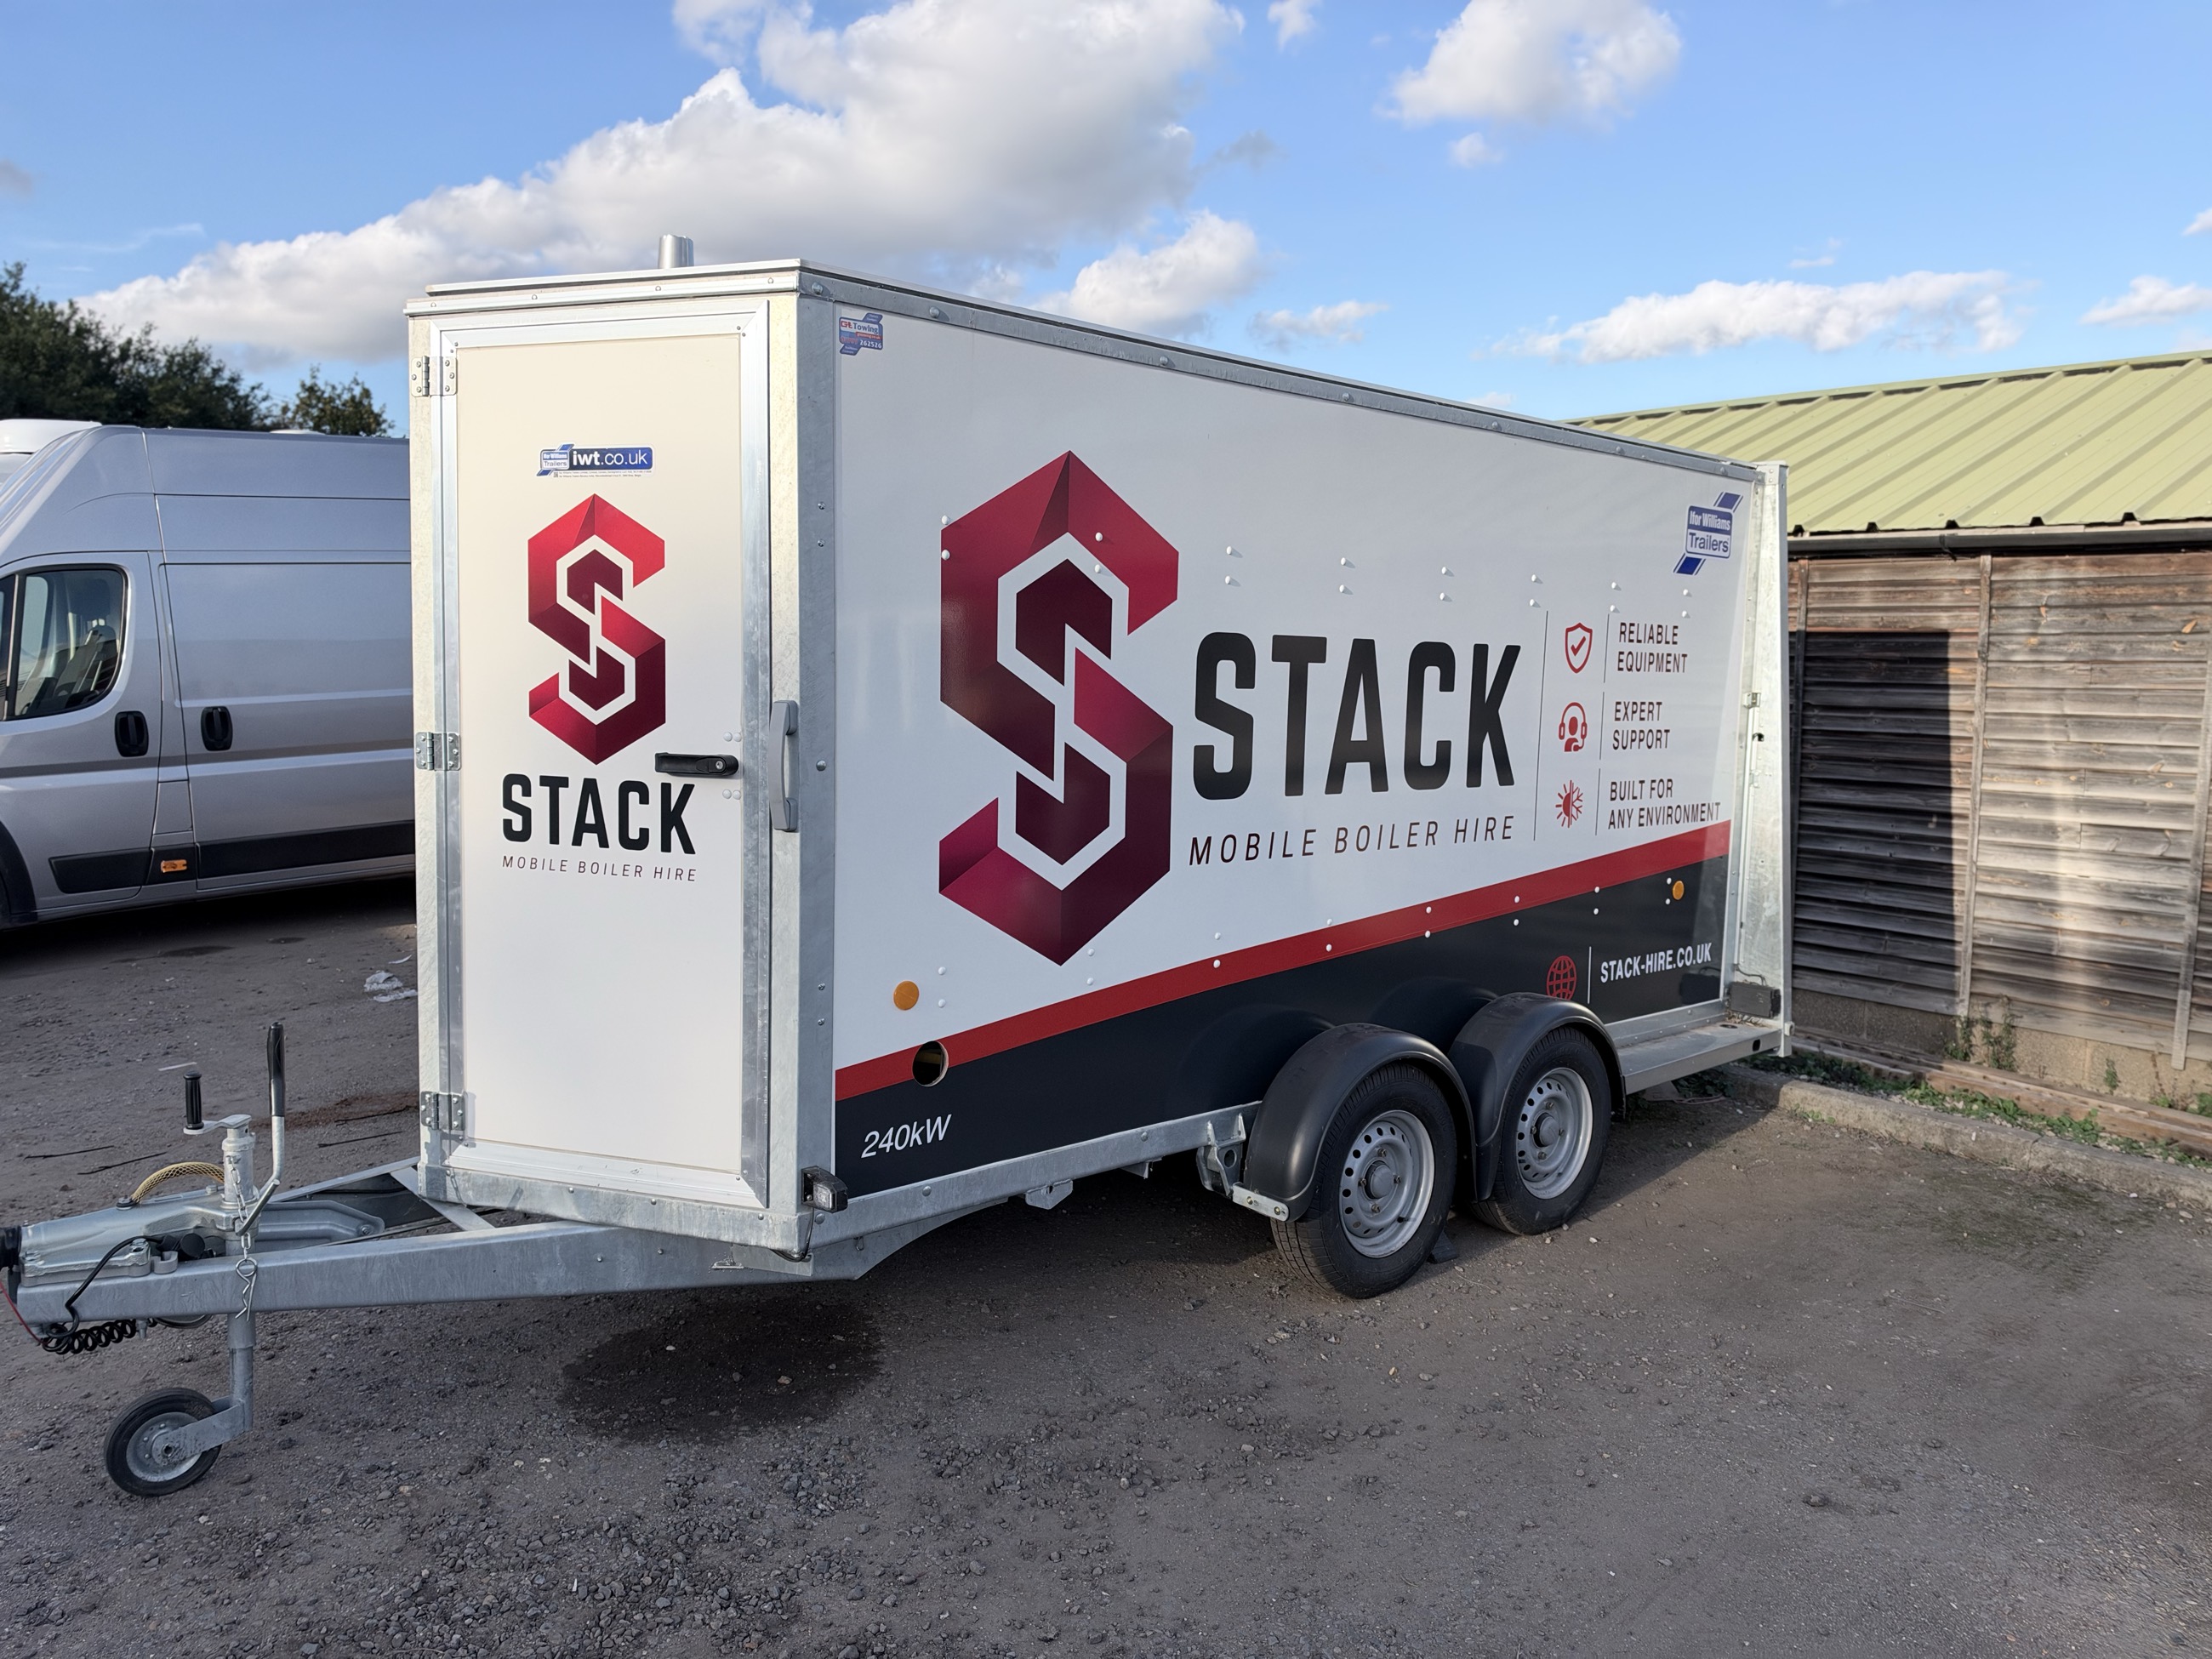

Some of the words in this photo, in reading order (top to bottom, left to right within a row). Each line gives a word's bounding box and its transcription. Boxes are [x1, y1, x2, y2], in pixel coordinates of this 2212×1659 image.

[859, 339, 881, 349] 262526
[573, 450, 648, 466] iwt.co.uk
[1689, 510, 1702, 526] Ifor
[1702, 512, 1730, 531] Williams
[1689, 532, 1730, 553] Trailers
[1618, 622, 1679, 646] RELIABLE
[1616, 651, 1688, 674] EQUIPMENT
[1193, 631, 1521, 800] STACK
[1614, 701, 1663, 721] EXPERT
[1612, 728, 1671, 750] SUPPORT
[1610, 779, 1645, 801] BUILT
[1649, 778, 1673, 799] FOR
[502, 772, 696, 855] STACK
[1608, 808, 1634, 830] ANY
[1638, 802, 1721, 828] ENVIRONMENT
[1189, 829, 1317, 866] MOBILE
[1334, 820, 1439, 854] BOILER
[1454, 815, 1515, 844] HIRE
[502, 855, 568, 873] MOBILE
[578, 860, 643, 879] BOILER
[653, 866, 697, 882] HIRE
[1599, 943, 1712, 983] STACK-HIRE.CO.UK
[860, 1113, 952, 1159] 240kW
